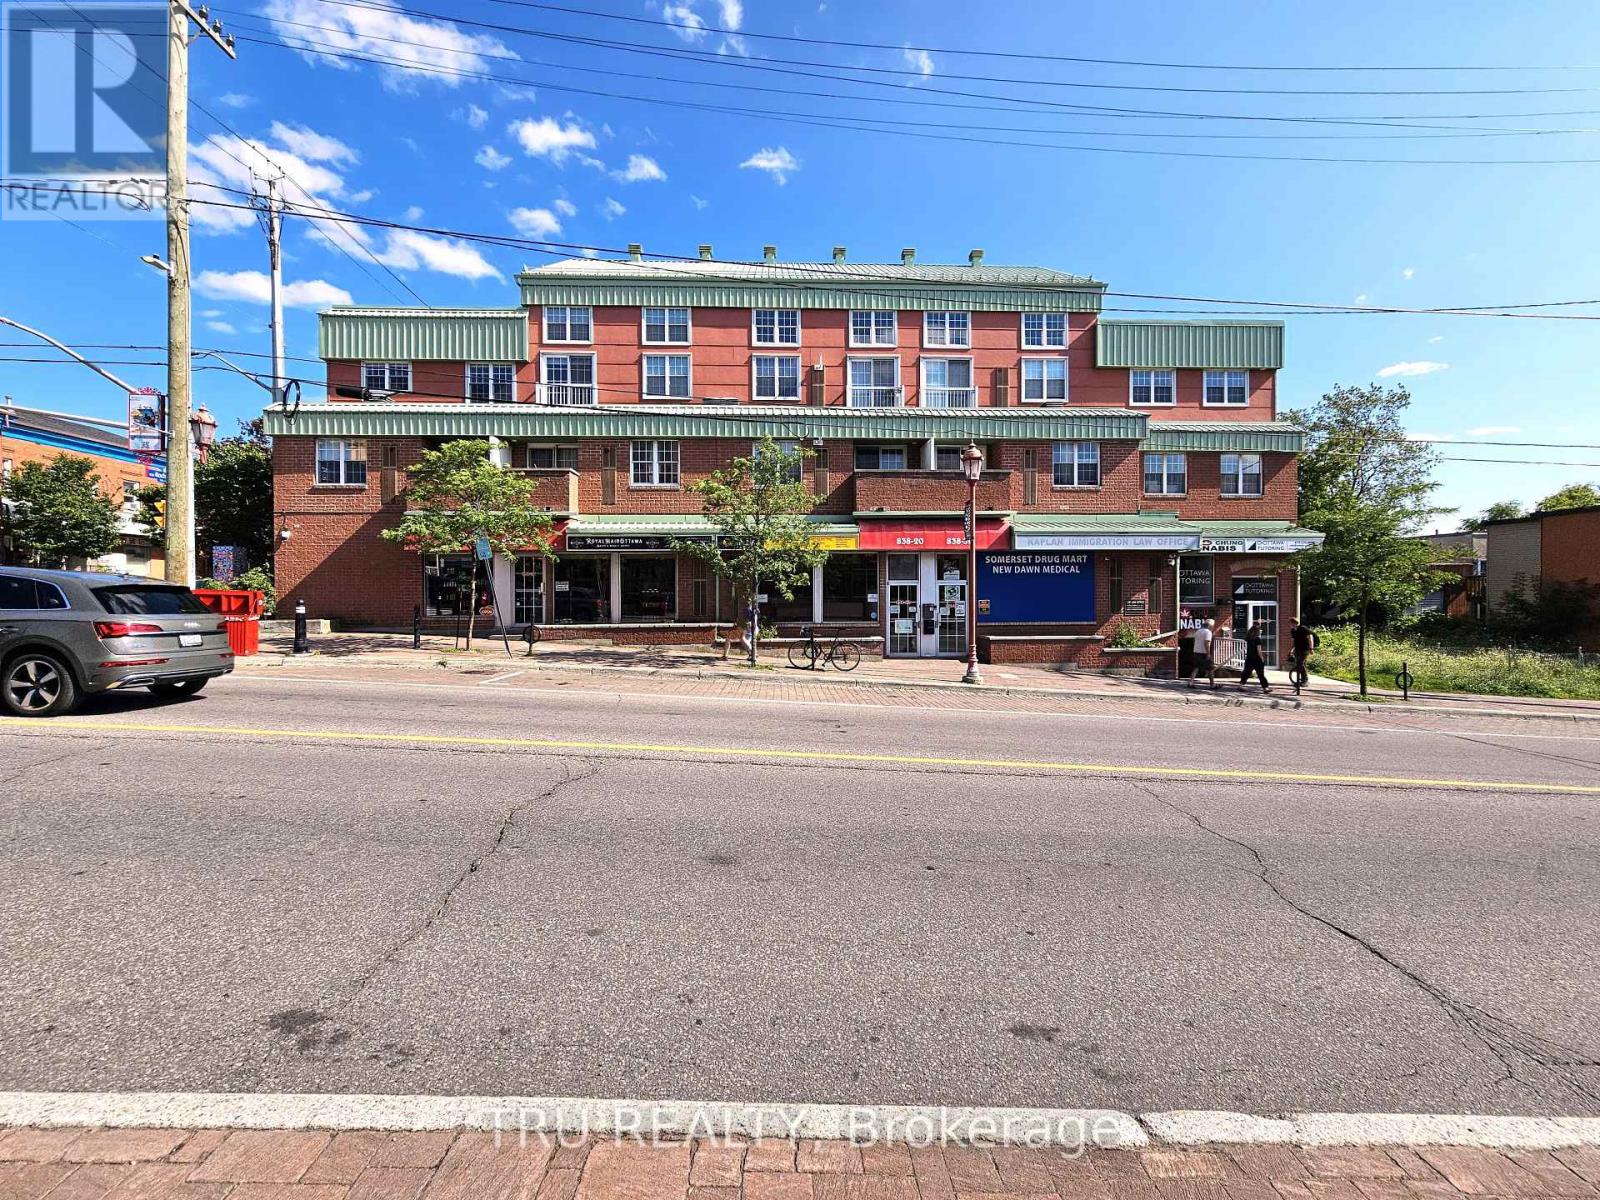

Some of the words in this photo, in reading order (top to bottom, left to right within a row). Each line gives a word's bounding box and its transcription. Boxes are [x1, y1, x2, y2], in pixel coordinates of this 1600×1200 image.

[1027, 537, 1064, 546] KAPLAN
[1068, 537, 1129, 546] IMMIGRATION
[1133, 537, 1154, 546] LAW
[1156, 537, 1188, 547] OFFICE
[985, 555, 1032, 564] SOMERSET
[1035, 555, 1060, 564] DRUG
[1062, 555, 1088, 564] MART
[992, 565, 1012, 574] NEW
[1014, 565, 1040, 574] DAWN
[1042, 565, 1081, 574] MEDICAL
